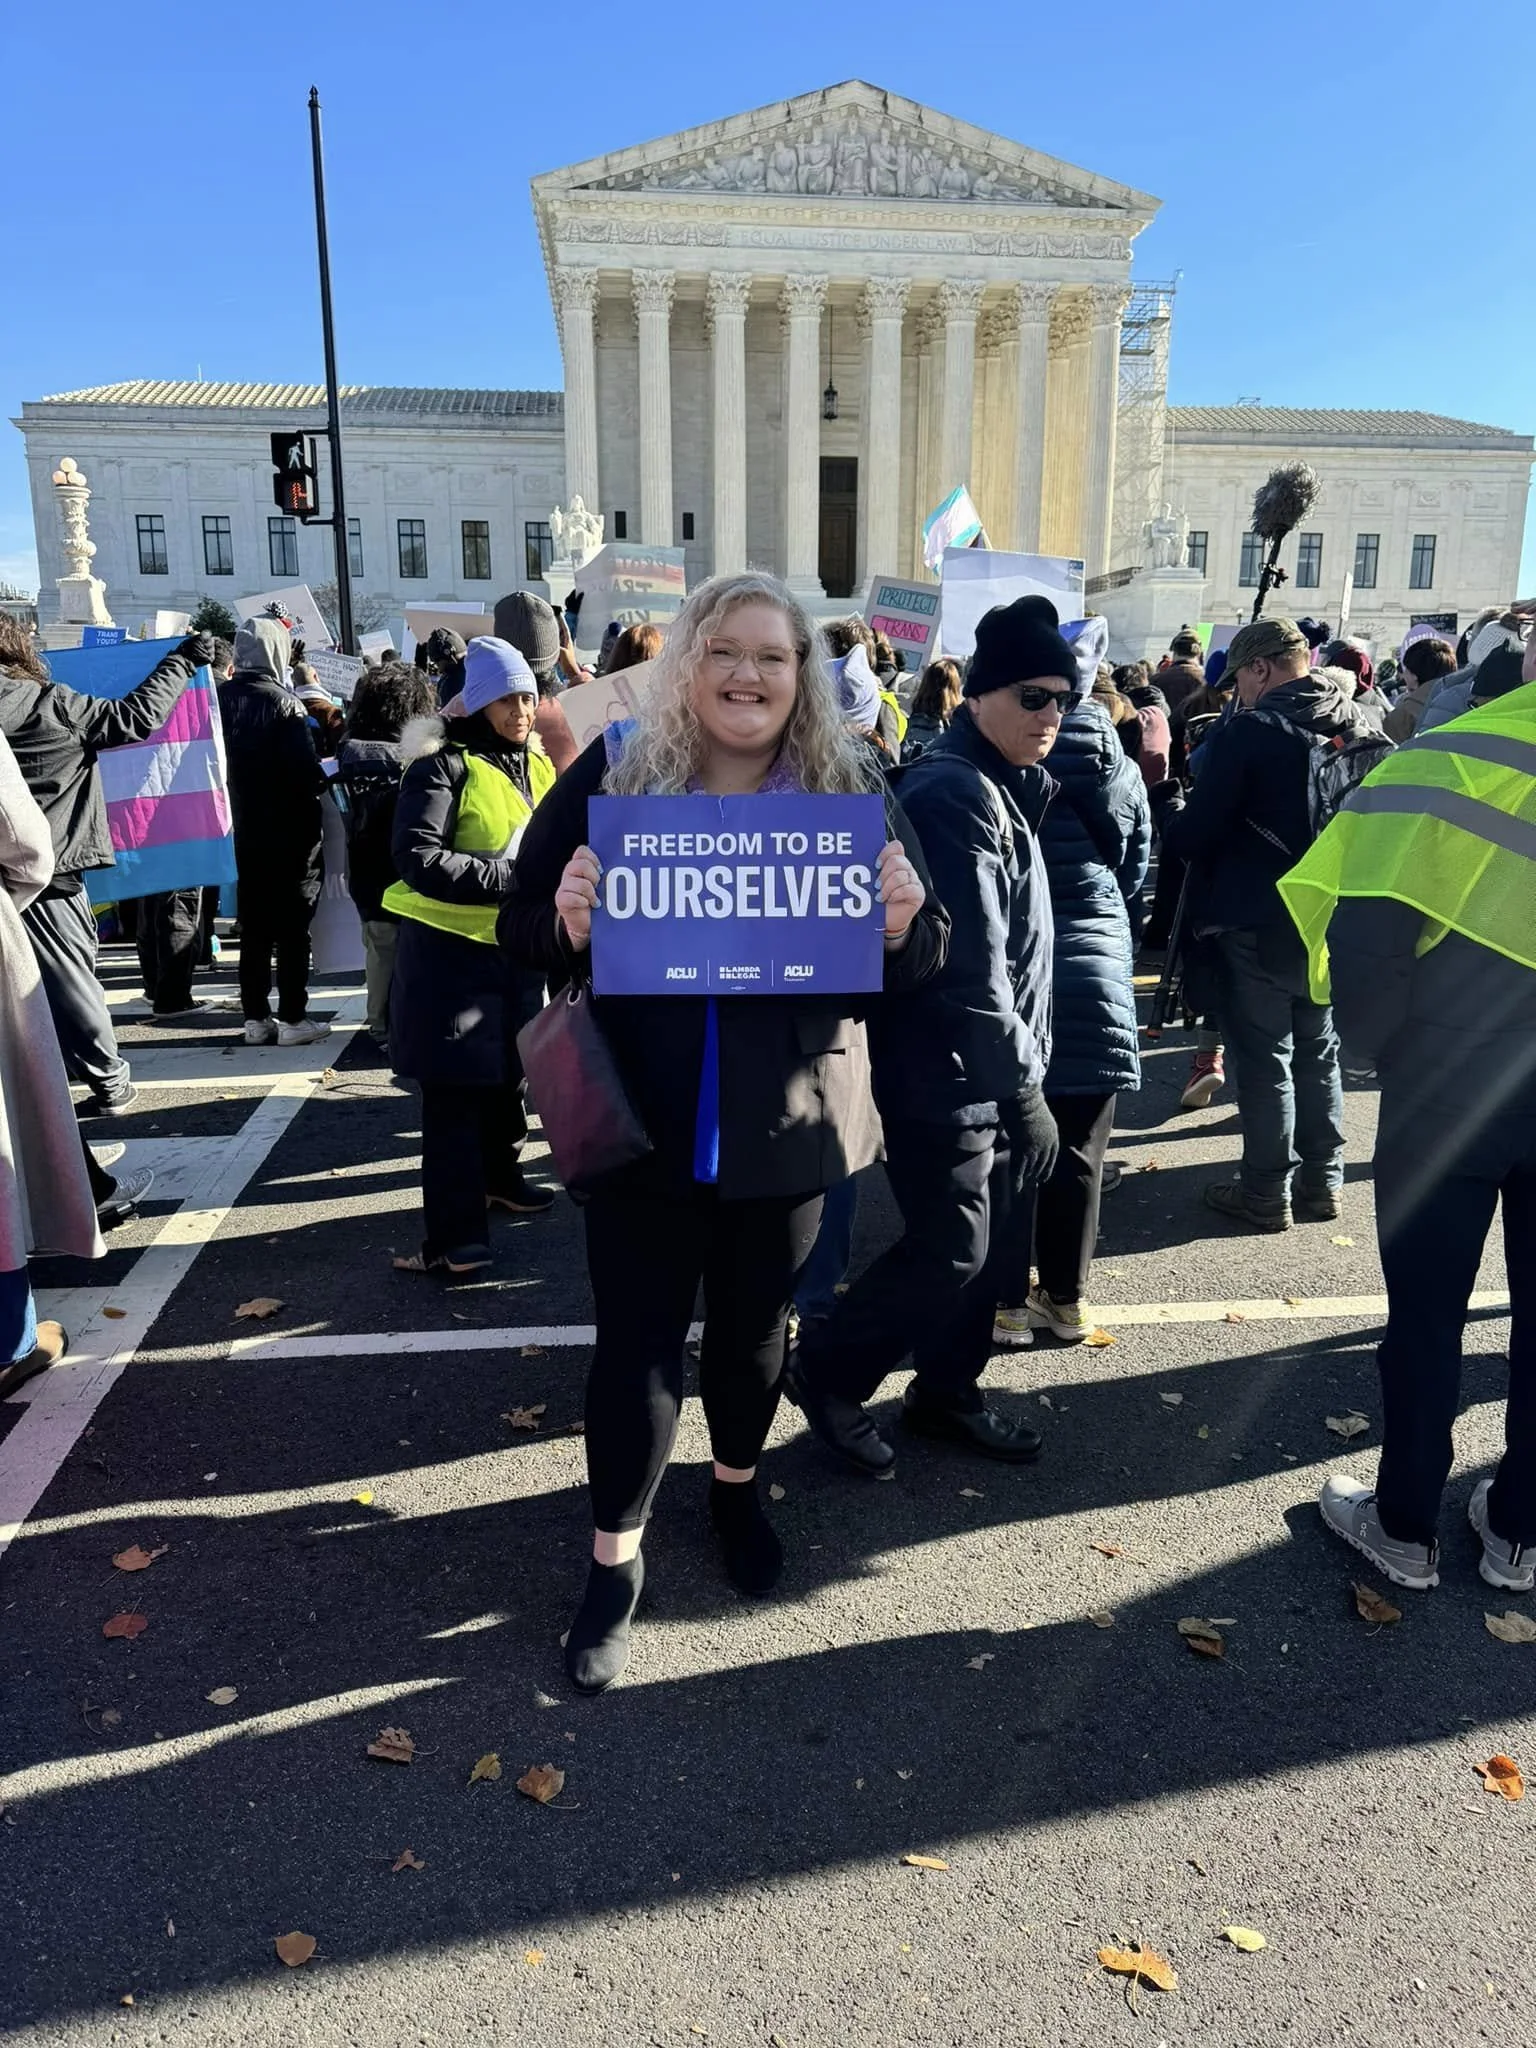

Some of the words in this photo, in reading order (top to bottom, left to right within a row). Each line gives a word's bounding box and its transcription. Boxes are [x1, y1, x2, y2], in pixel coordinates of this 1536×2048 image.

[868, 234, 920, 249] UNDER
[881, 588, 933, 612] PROTECT
[884, 619, 921, 640] TRANS
[623, 832, 762, 857] FREEDOM
[770, 832, 809, 856] TO
[817, 832, 852, 855] BE
[606, 864, 872, 919] OURSELVES
[666, 967, 697, 979] ACLU
[784, 965, 814, 977] ACLU
